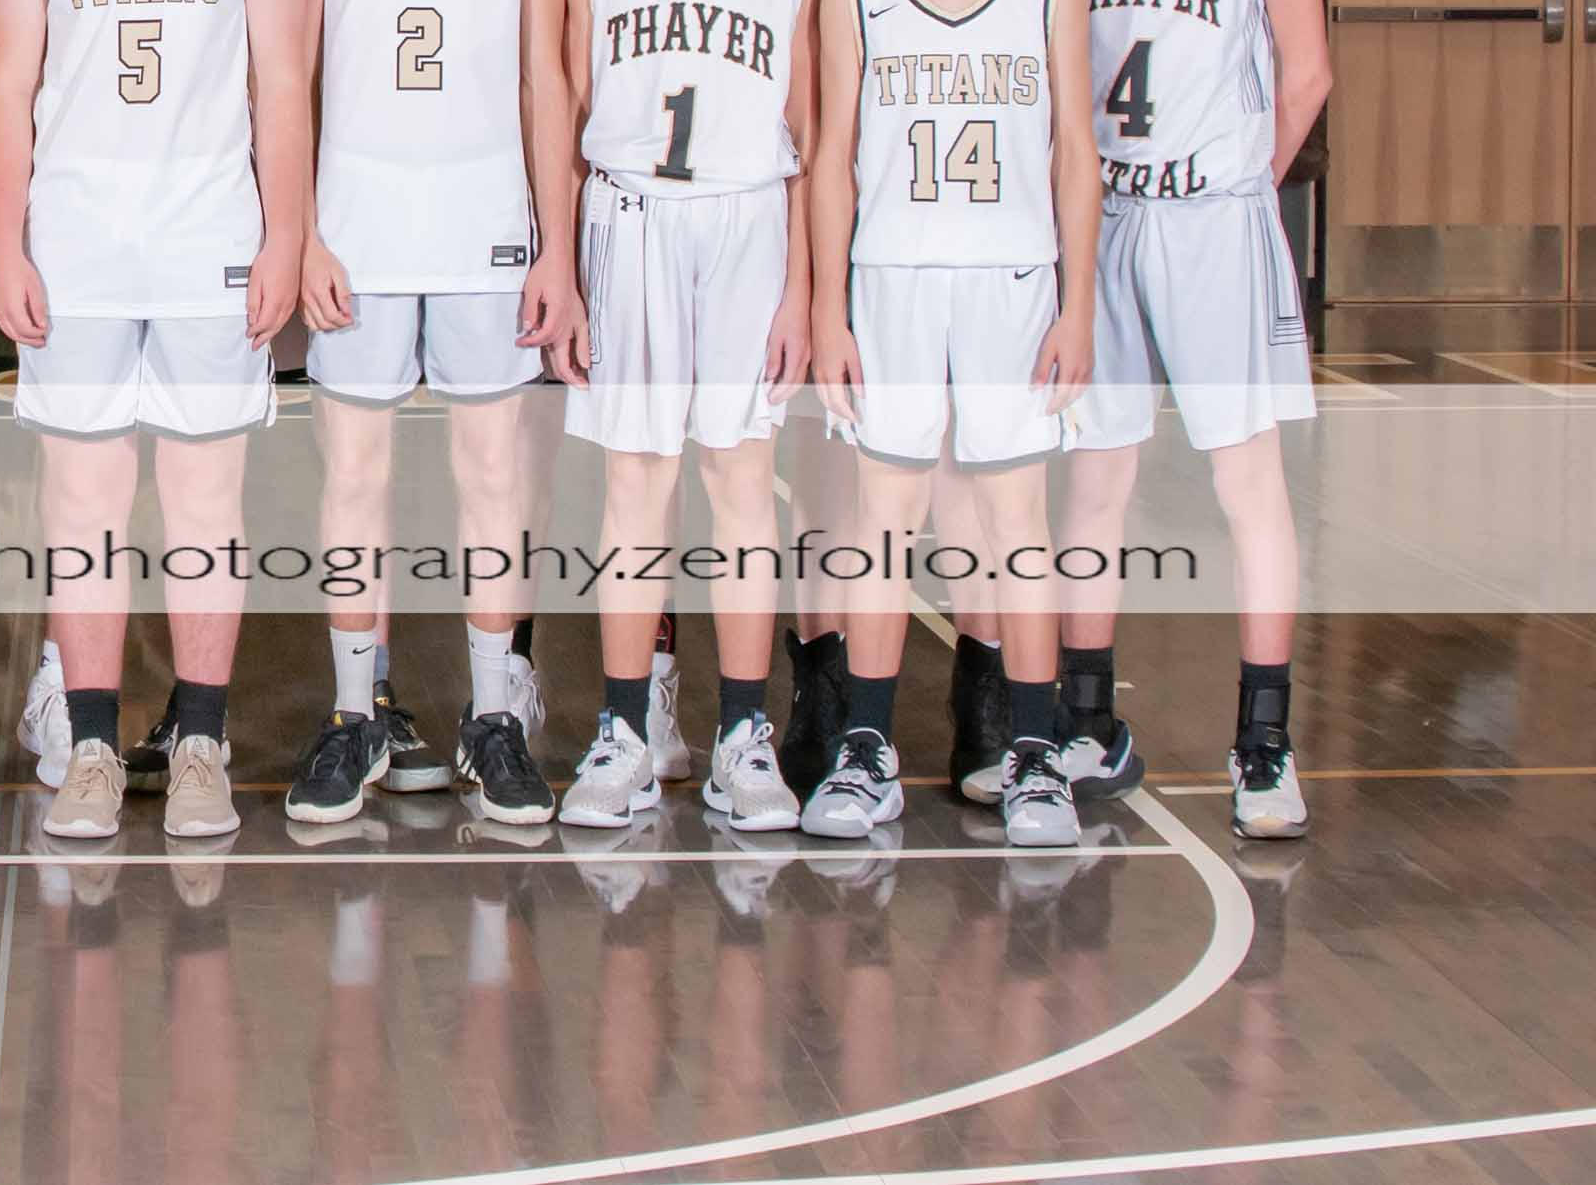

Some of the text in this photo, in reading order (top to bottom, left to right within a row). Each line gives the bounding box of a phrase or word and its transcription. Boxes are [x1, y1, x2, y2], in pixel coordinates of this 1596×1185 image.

[118, 19, 162, 104] 5
[396, 7, 444, 91] 2
[607, 2, 774, 80] THAYER
[873, 54, 1039, 106] TITANS
[1105, 37, 1156, 139] 4
[653, 84, 696, 182] 1
[908, 120, 1001, 202] 14
[1099, 150, 1207, 198] TRAL
